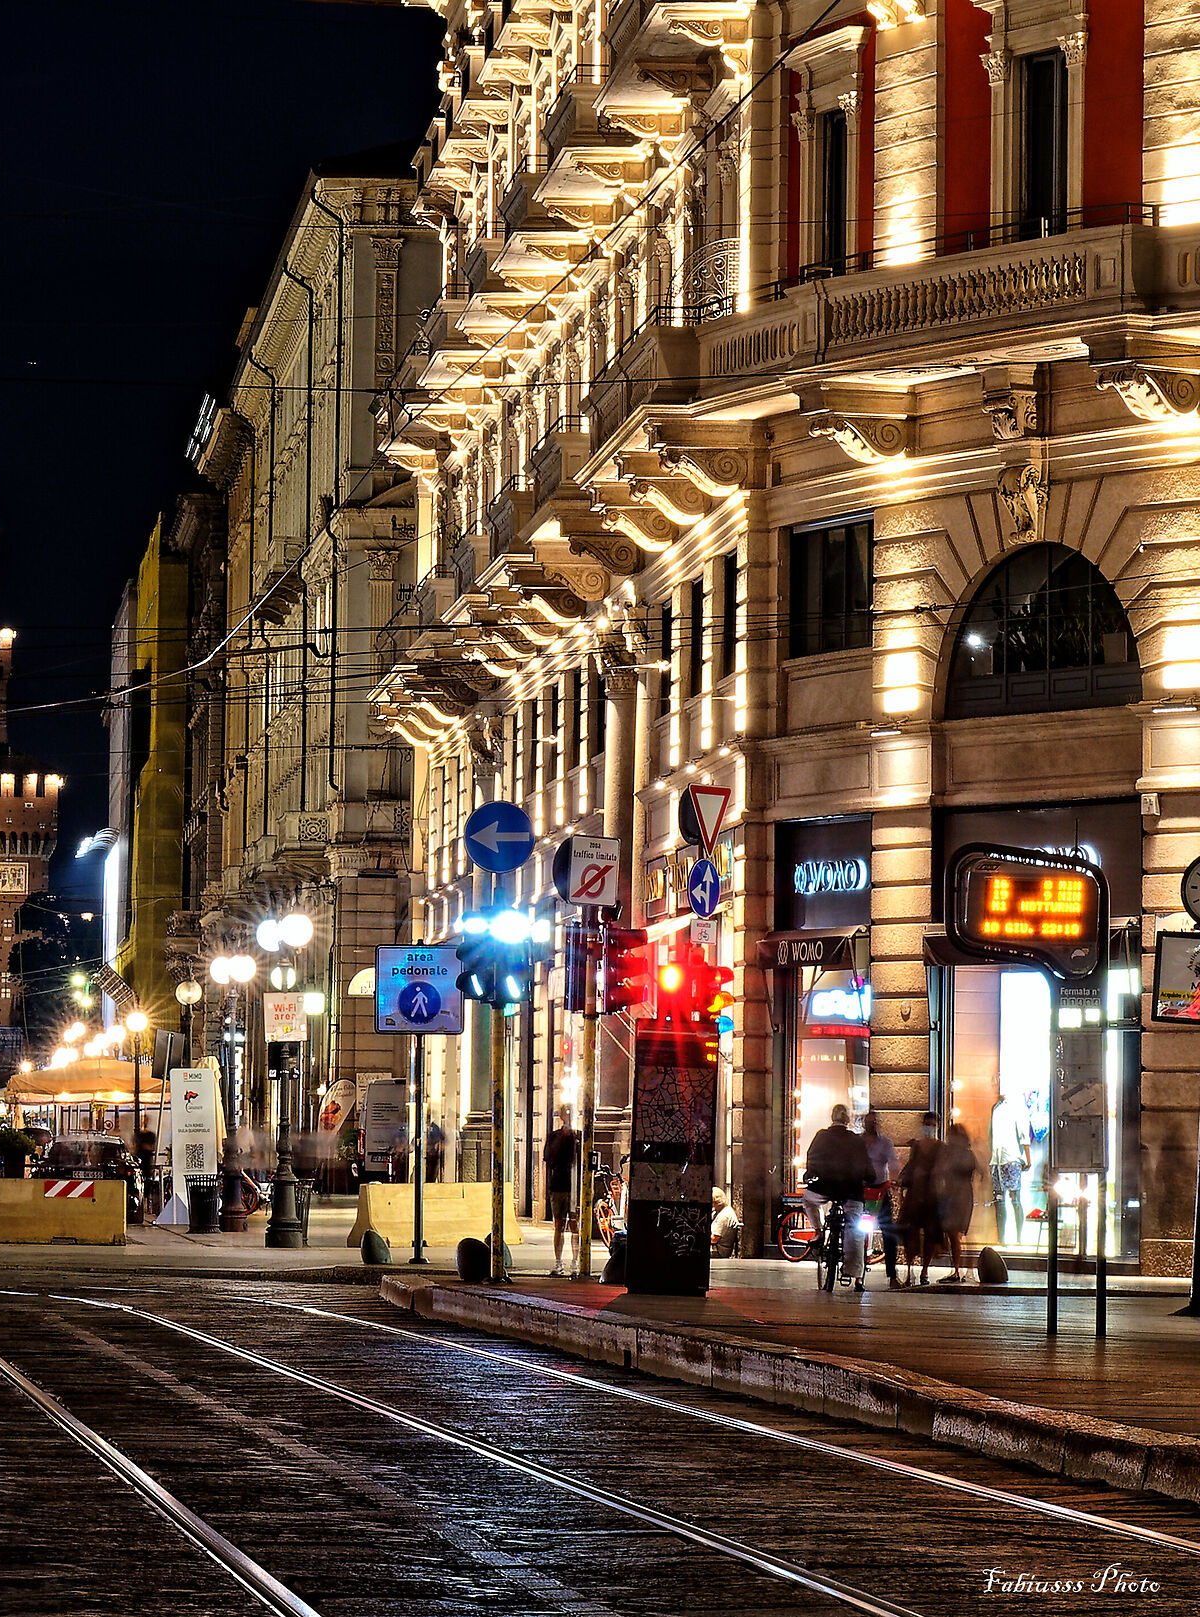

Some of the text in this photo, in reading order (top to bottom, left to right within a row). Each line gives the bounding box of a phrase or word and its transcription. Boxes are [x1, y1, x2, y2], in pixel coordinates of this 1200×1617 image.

[573, 849, 617, 862] traffico limitato
[993, 879, 1009, 889] 16
[993, 889, 1009, 900] 19
[1057, 890, 1082, 901] MIN
[991, 900, 1081, 912] N1 NOTTURNA
[984, 921, 1080, 935] 10 GIU. 22:10
[406, 952, 434, 962] area
[792, 941, 823, 961] WOMO
[391, 965, 448, 977] pedonale
[1060, 987, 1090, 996] Fermata
[273, 1003, 297, 1012] Wi-Fi
